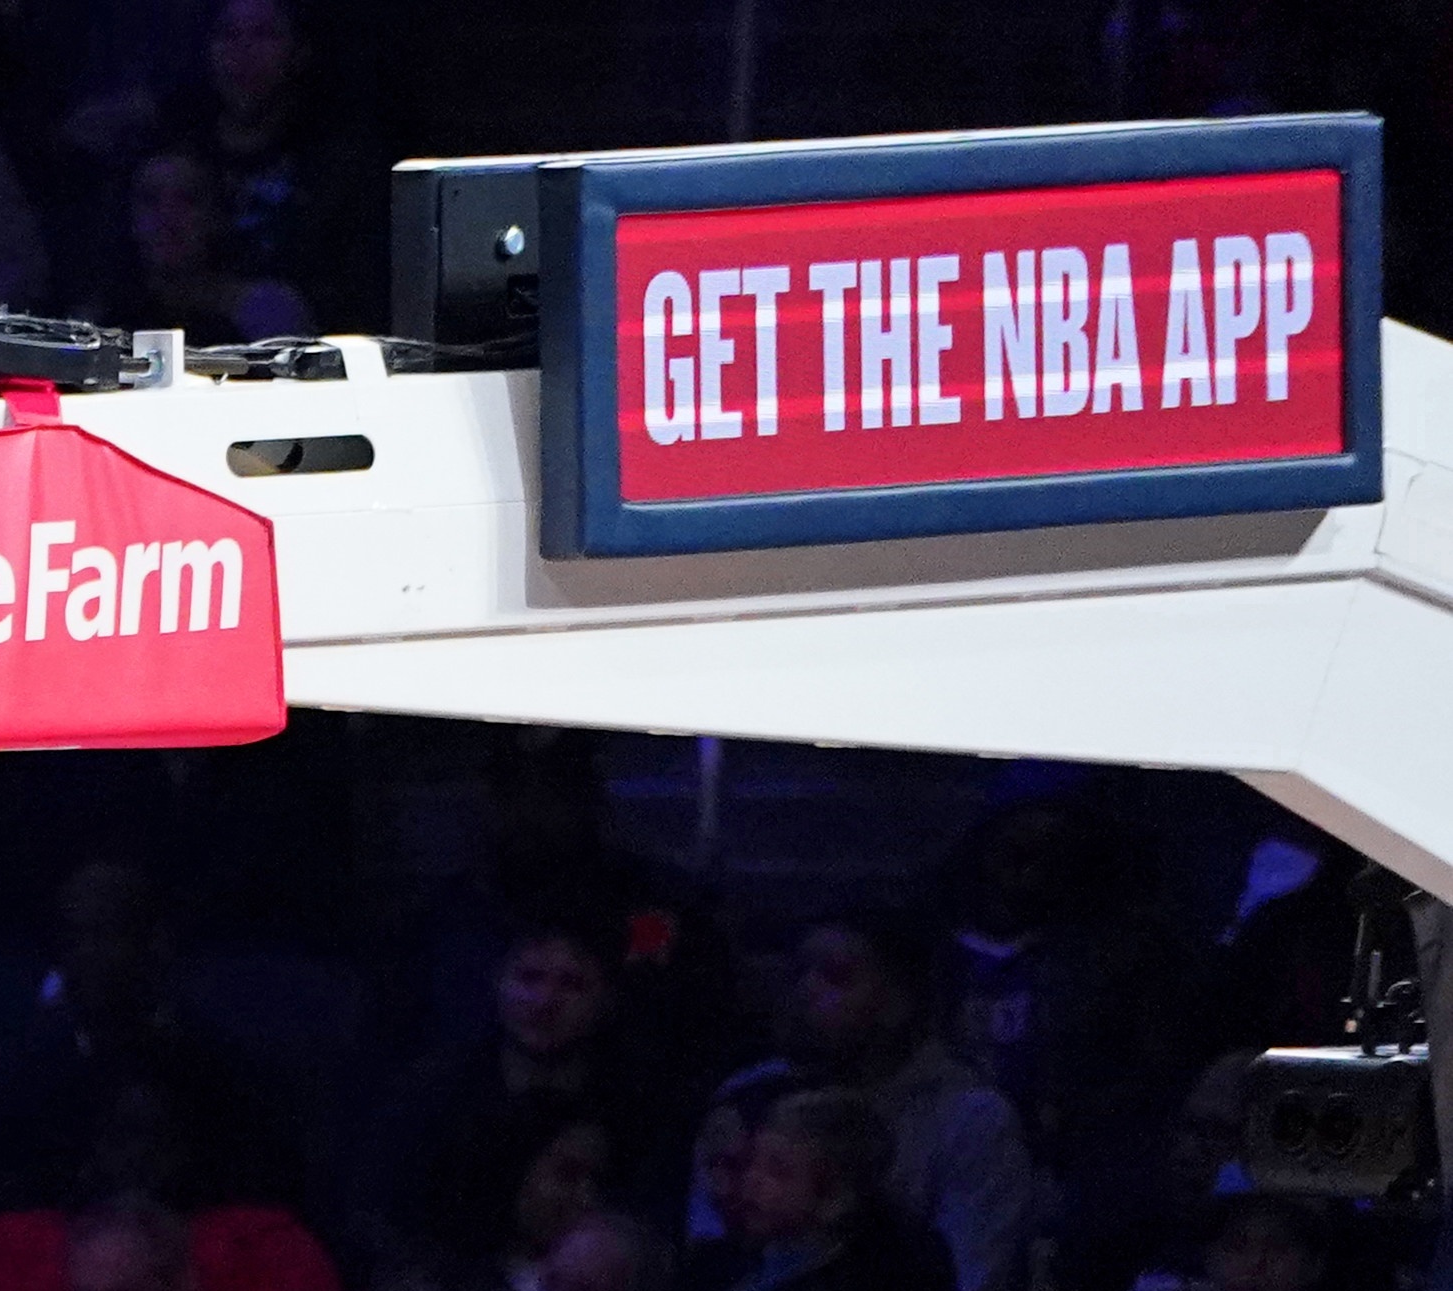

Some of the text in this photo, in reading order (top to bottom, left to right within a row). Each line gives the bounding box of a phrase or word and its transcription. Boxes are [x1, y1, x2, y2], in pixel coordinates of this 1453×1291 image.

[642, 231, 1313, 446] GET THE NBA APP
